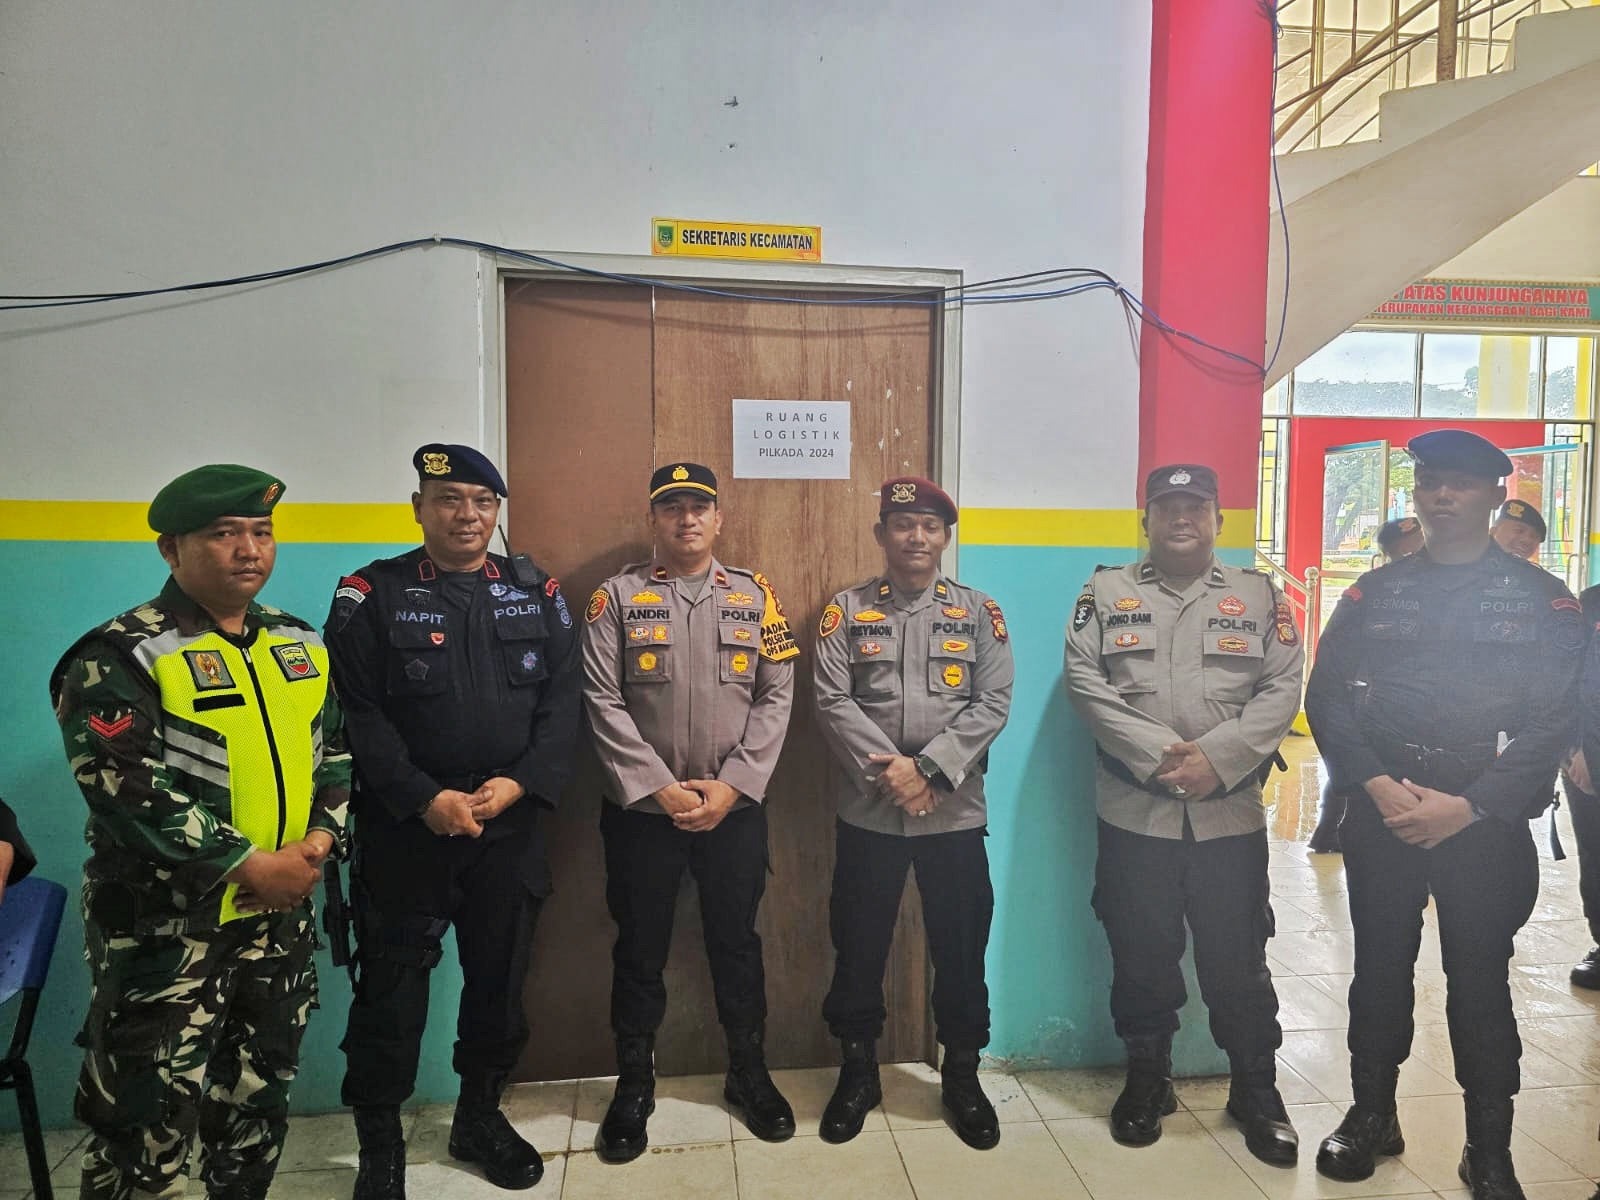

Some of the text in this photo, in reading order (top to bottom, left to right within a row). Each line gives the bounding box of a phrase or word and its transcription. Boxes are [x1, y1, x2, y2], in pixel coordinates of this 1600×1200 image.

[682, 229, 813, 251] SEKRETARIS KECAMATAN
[1404, 285, 1588, 305] ATAS KUNJUNGANNYA
[1447, 304, 1526, 317] KEBANGGAAN
[1529, 306, 1557, 317] BAGI
[1559, 306, 1590, 318] KAMI
[766, 412, 827, 422] RUANG
[753, 429, 840, 440] LOGISTIK
[759, 447, 834, 458] PILKADA 2024
[395, 610, 444, 625] NAPIT
[494, 604, 540, 619] POLRI
[627, 608, 670, 621] ANDRI
[721, 609, 760, 623] POLRI
[932, 622, 975, 635] POLRI
[1208, 617, 1257, 632] POLRI
